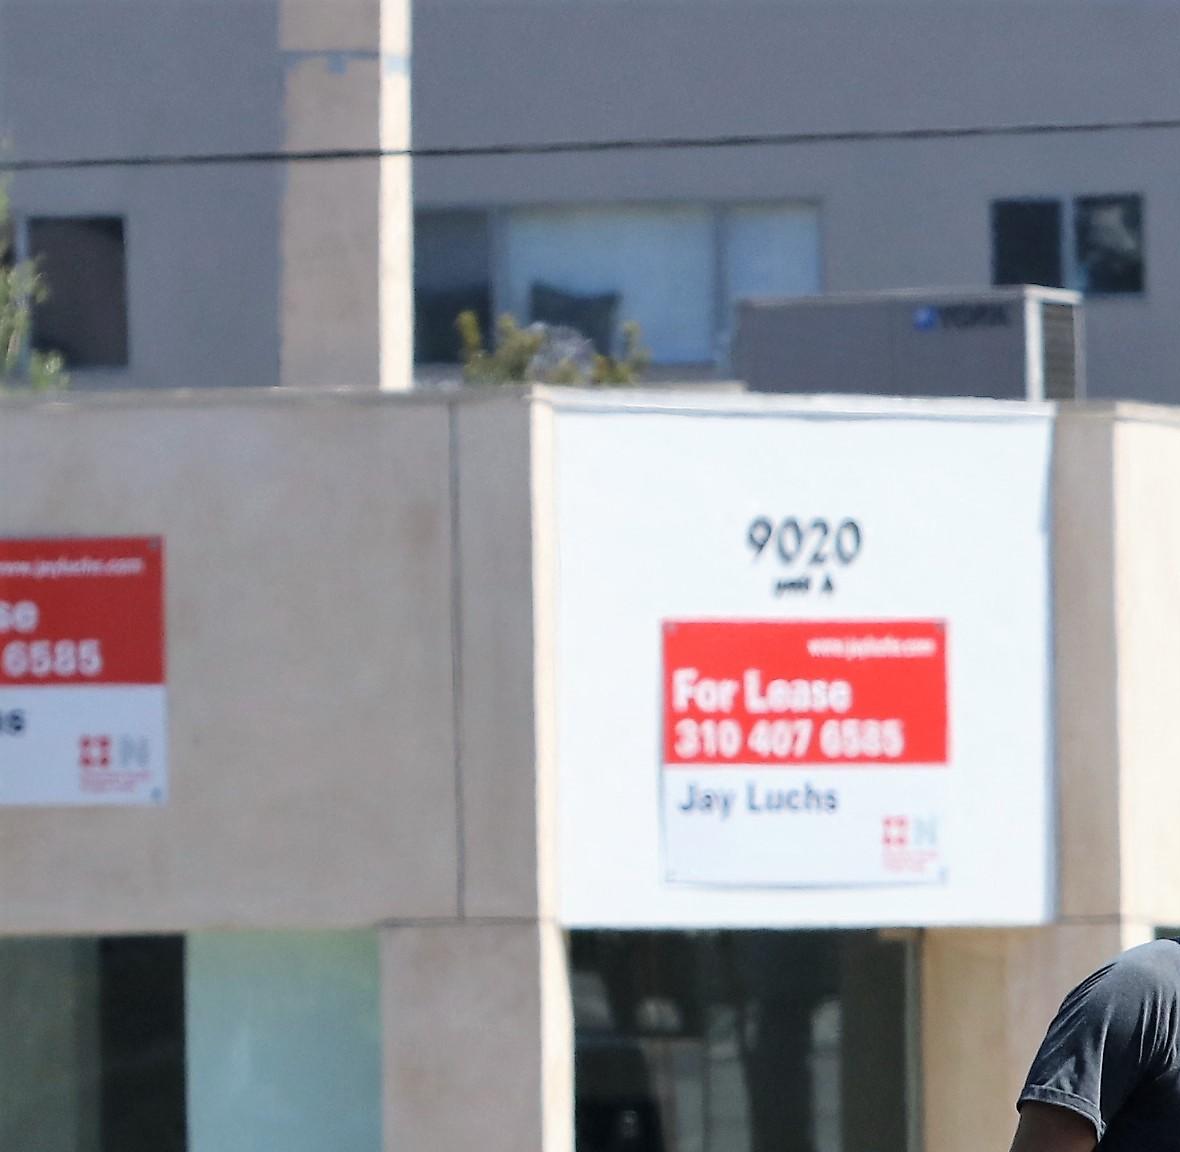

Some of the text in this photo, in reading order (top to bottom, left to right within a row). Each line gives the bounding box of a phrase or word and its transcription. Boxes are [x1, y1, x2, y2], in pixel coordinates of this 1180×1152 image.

[746, 516, 862, 565] 9020
[4, 638, 103, 676] 6585
[672, 667, 852, 714] For Lease
[675, 718, 904, 758] 310 407 6585
[678, 780, 838, 822] Jay Luchs
